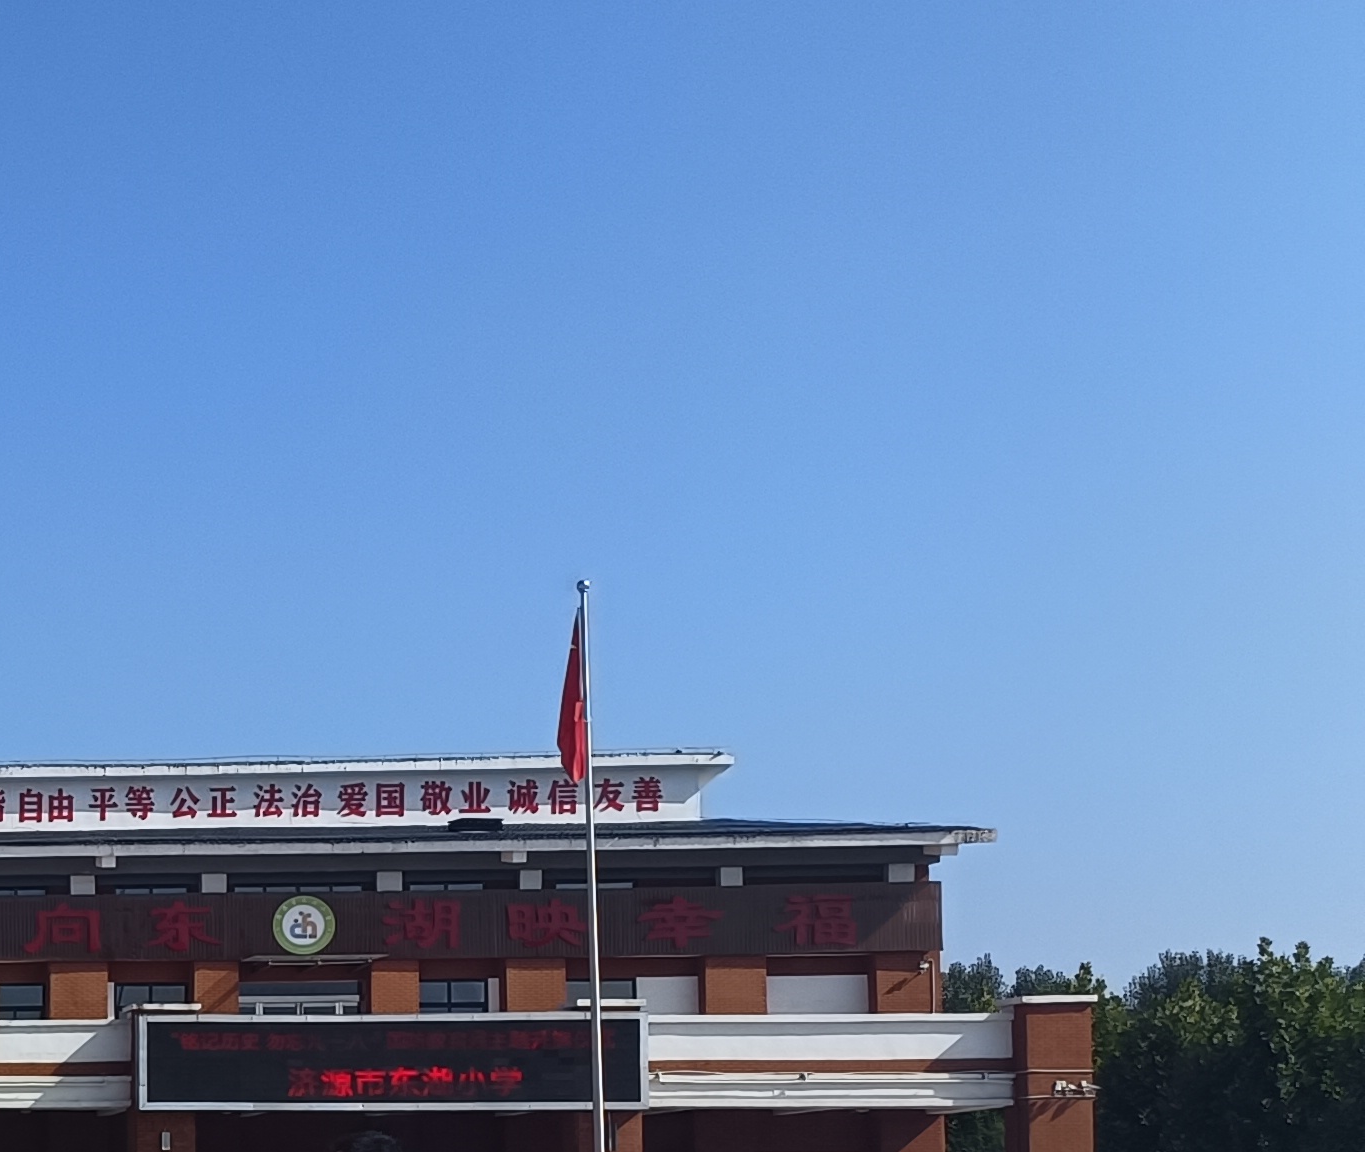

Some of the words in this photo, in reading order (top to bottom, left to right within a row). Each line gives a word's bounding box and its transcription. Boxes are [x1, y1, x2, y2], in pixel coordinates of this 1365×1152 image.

[18, 788, 75, 822] 自由
[90, 785, 156, 821] 平等
[170, 785, 238, 819] 公正
[253, 783, 322, 818] 法治
[337, 781, 406, 818] 爱国
[420, 780, 492, 816] 敬业
[508, 779, 578, 815] 诚信
[594, 776, 664, 813] 友善
[382, 895, 859, 951] 湖映幸福
[287, 1067, 522, 1097] 济源市东湖小学
